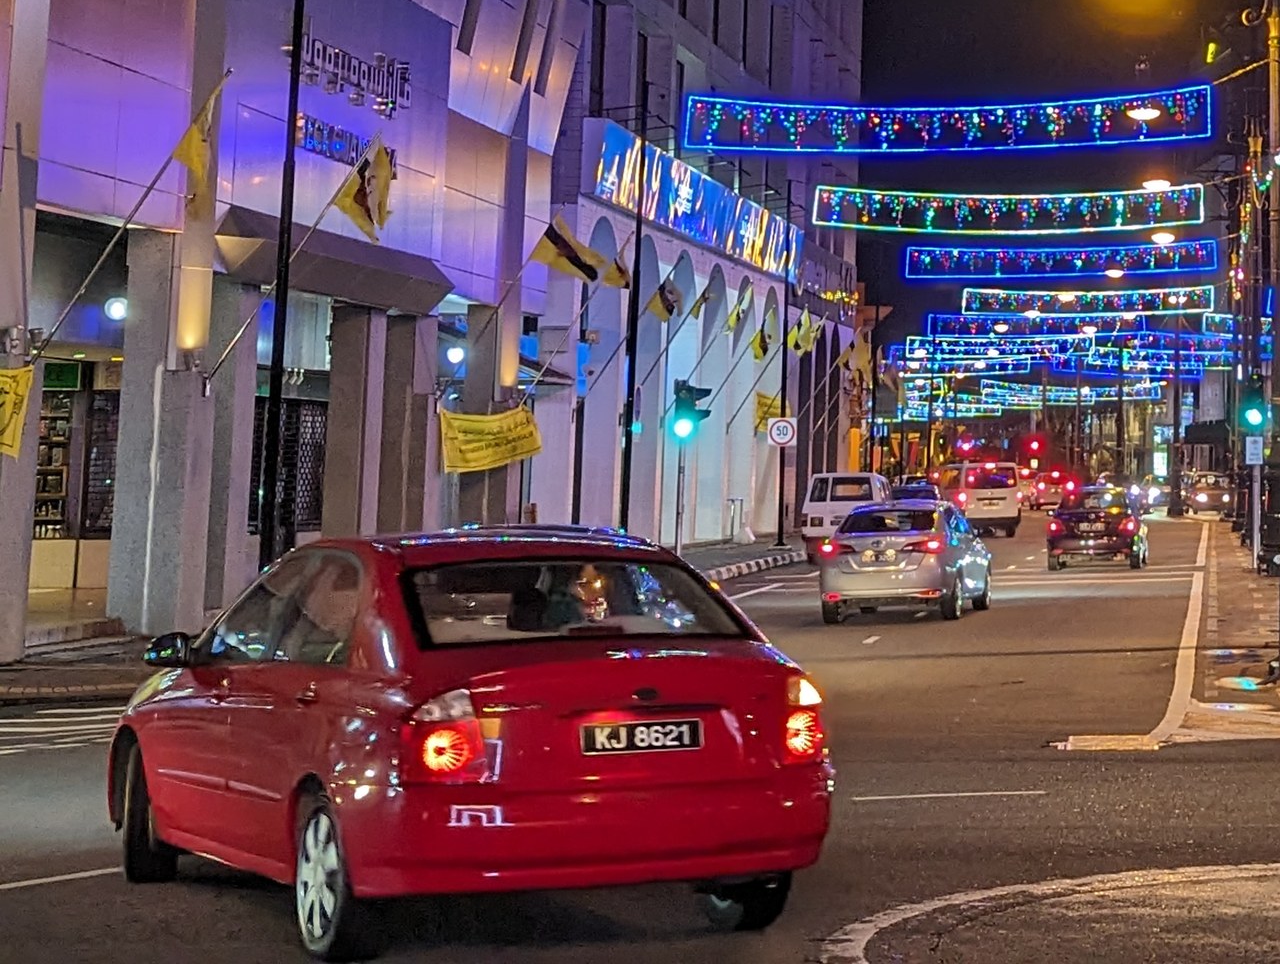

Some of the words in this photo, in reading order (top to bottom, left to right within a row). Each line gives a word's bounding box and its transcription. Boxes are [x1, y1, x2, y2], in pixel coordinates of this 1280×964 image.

[776, 425, 788, 436] 50
[594, 726, 628, 750] KJ
[633, 723, 691, 747] 8621
